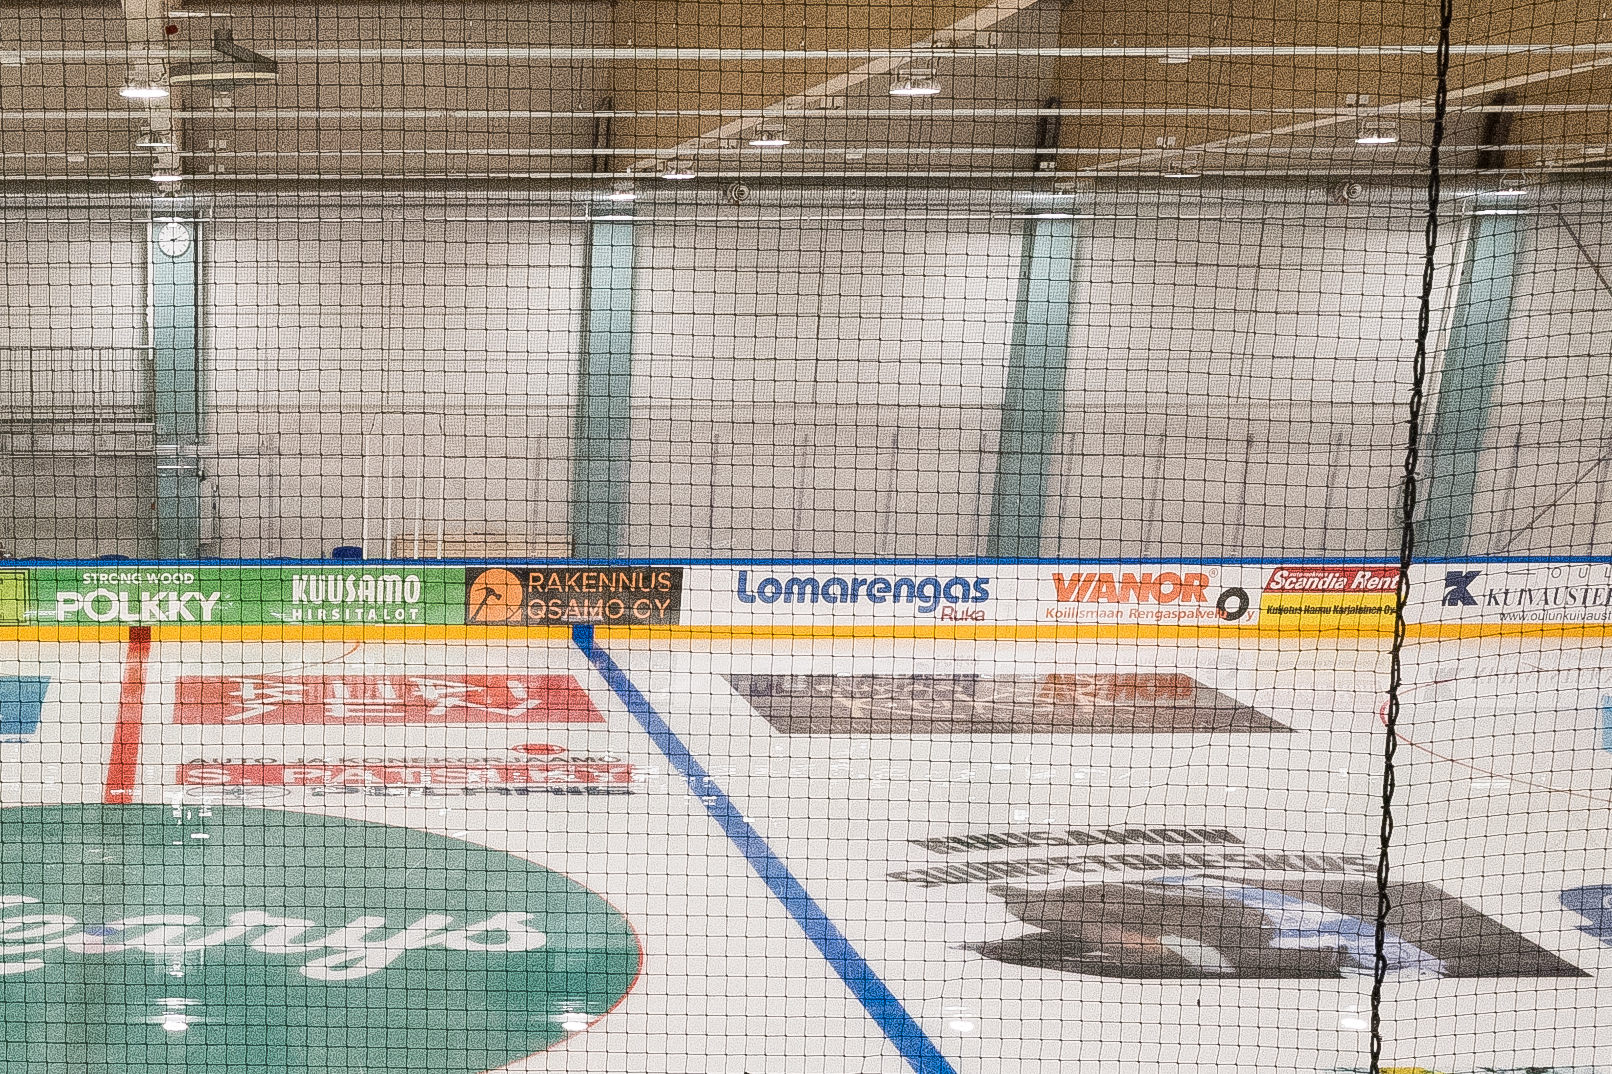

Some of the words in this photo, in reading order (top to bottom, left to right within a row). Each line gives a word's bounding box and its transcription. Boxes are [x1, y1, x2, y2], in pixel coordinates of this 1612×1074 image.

[82, 573, 143, 584] STRONG
[146, 573, 195, 584] WOOD
[528, 572, 672, 593] RAKENNUS
[1270, 570, 1348, 590] Scandia
[1351, 570, 1400, 590] Rent
[291, 575, 421, 605] KUUSAMO
[737, 570, 990, 613] Lomarengas
[56, 588, 221, 622] PÖLKKY
[291, 608, 419, 620] HIRSITALOT
[527, 599, 625, 620] QSAMO
[632, 599, 672, 619] OY
[940, 605, 986, 622] Ruka
[1045, 607, 1124, 619] Koillismaan
